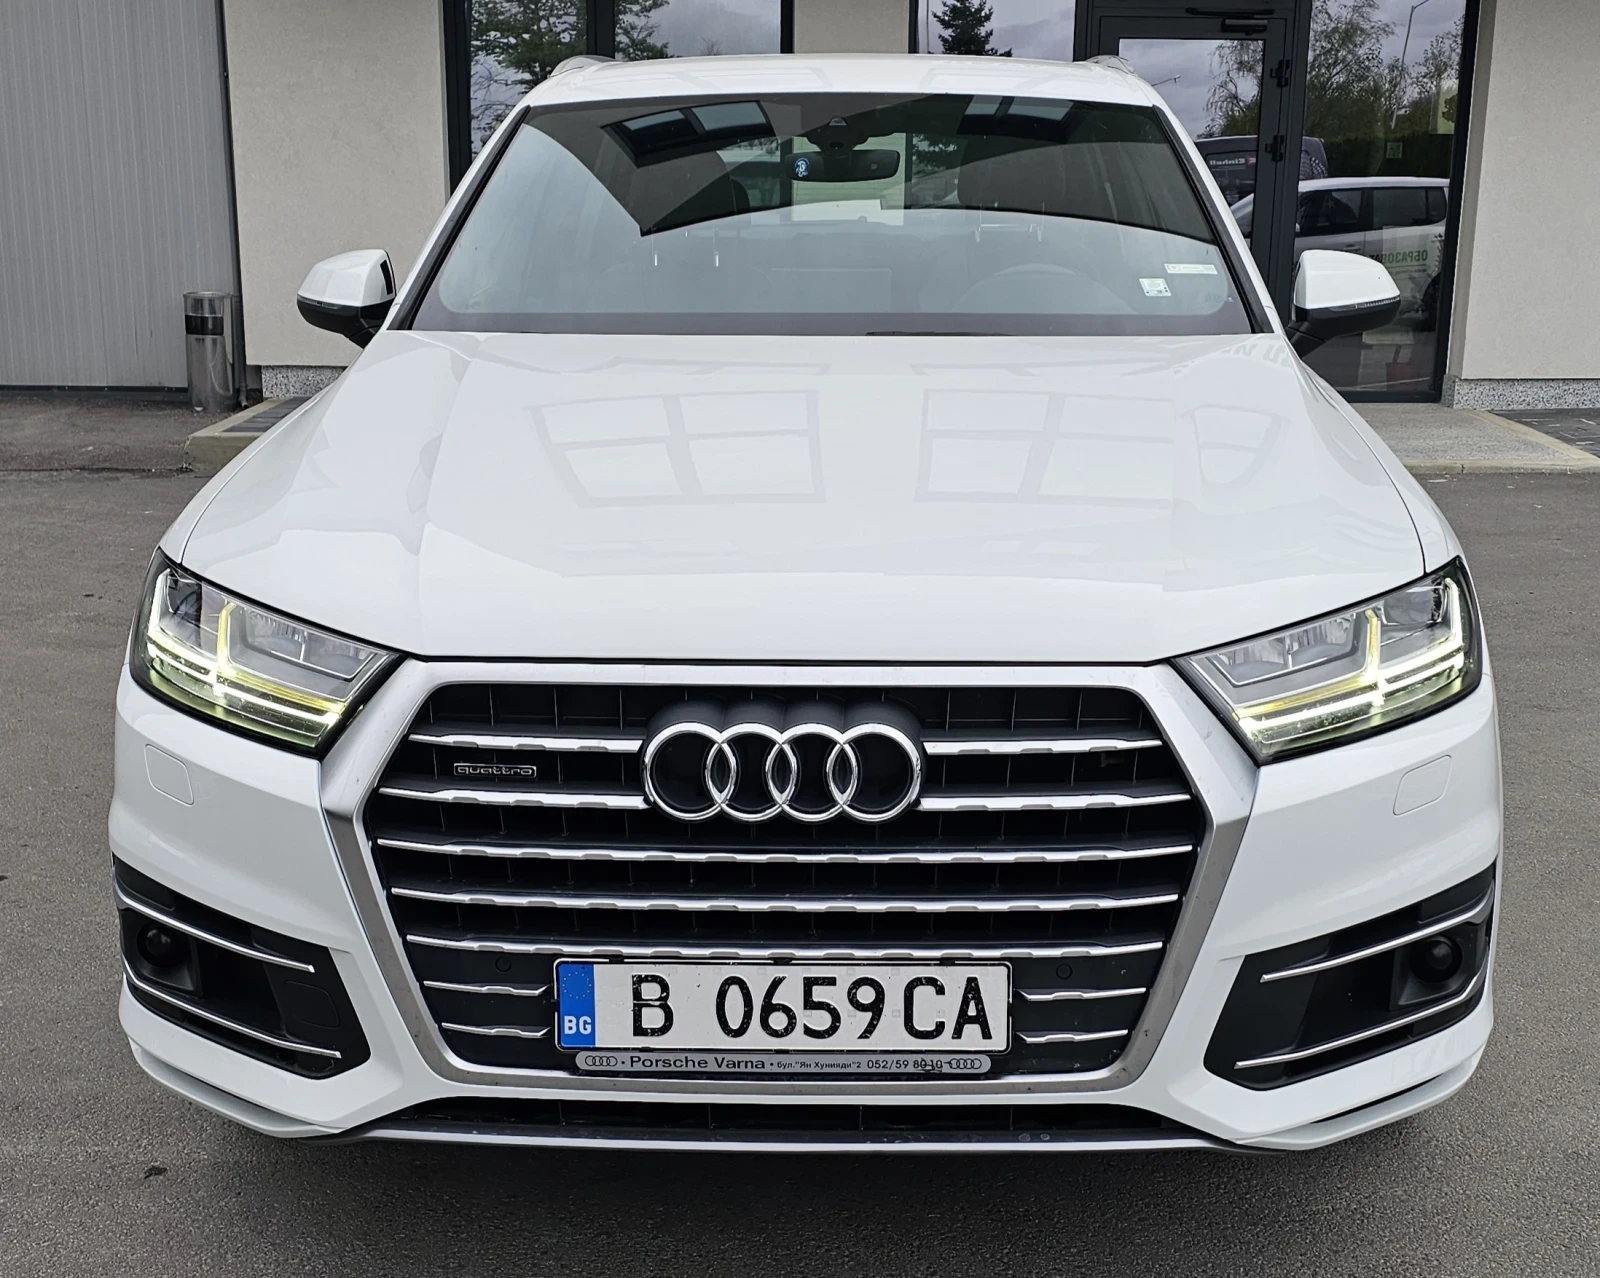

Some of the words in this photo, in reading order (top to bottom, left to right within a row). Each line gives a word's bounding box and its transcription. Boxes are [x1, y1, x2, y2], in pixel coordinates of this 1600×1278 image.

[457, 766, 533, 775] quattro
[632, 974, 674, 1037] B
[564, 1015, 592, 1035] BG
[630, 1055, 709, 1069] Porsche
[714, 1056, 765, 1069] Varna
[867, 1059, 909, 1070] 052/59
